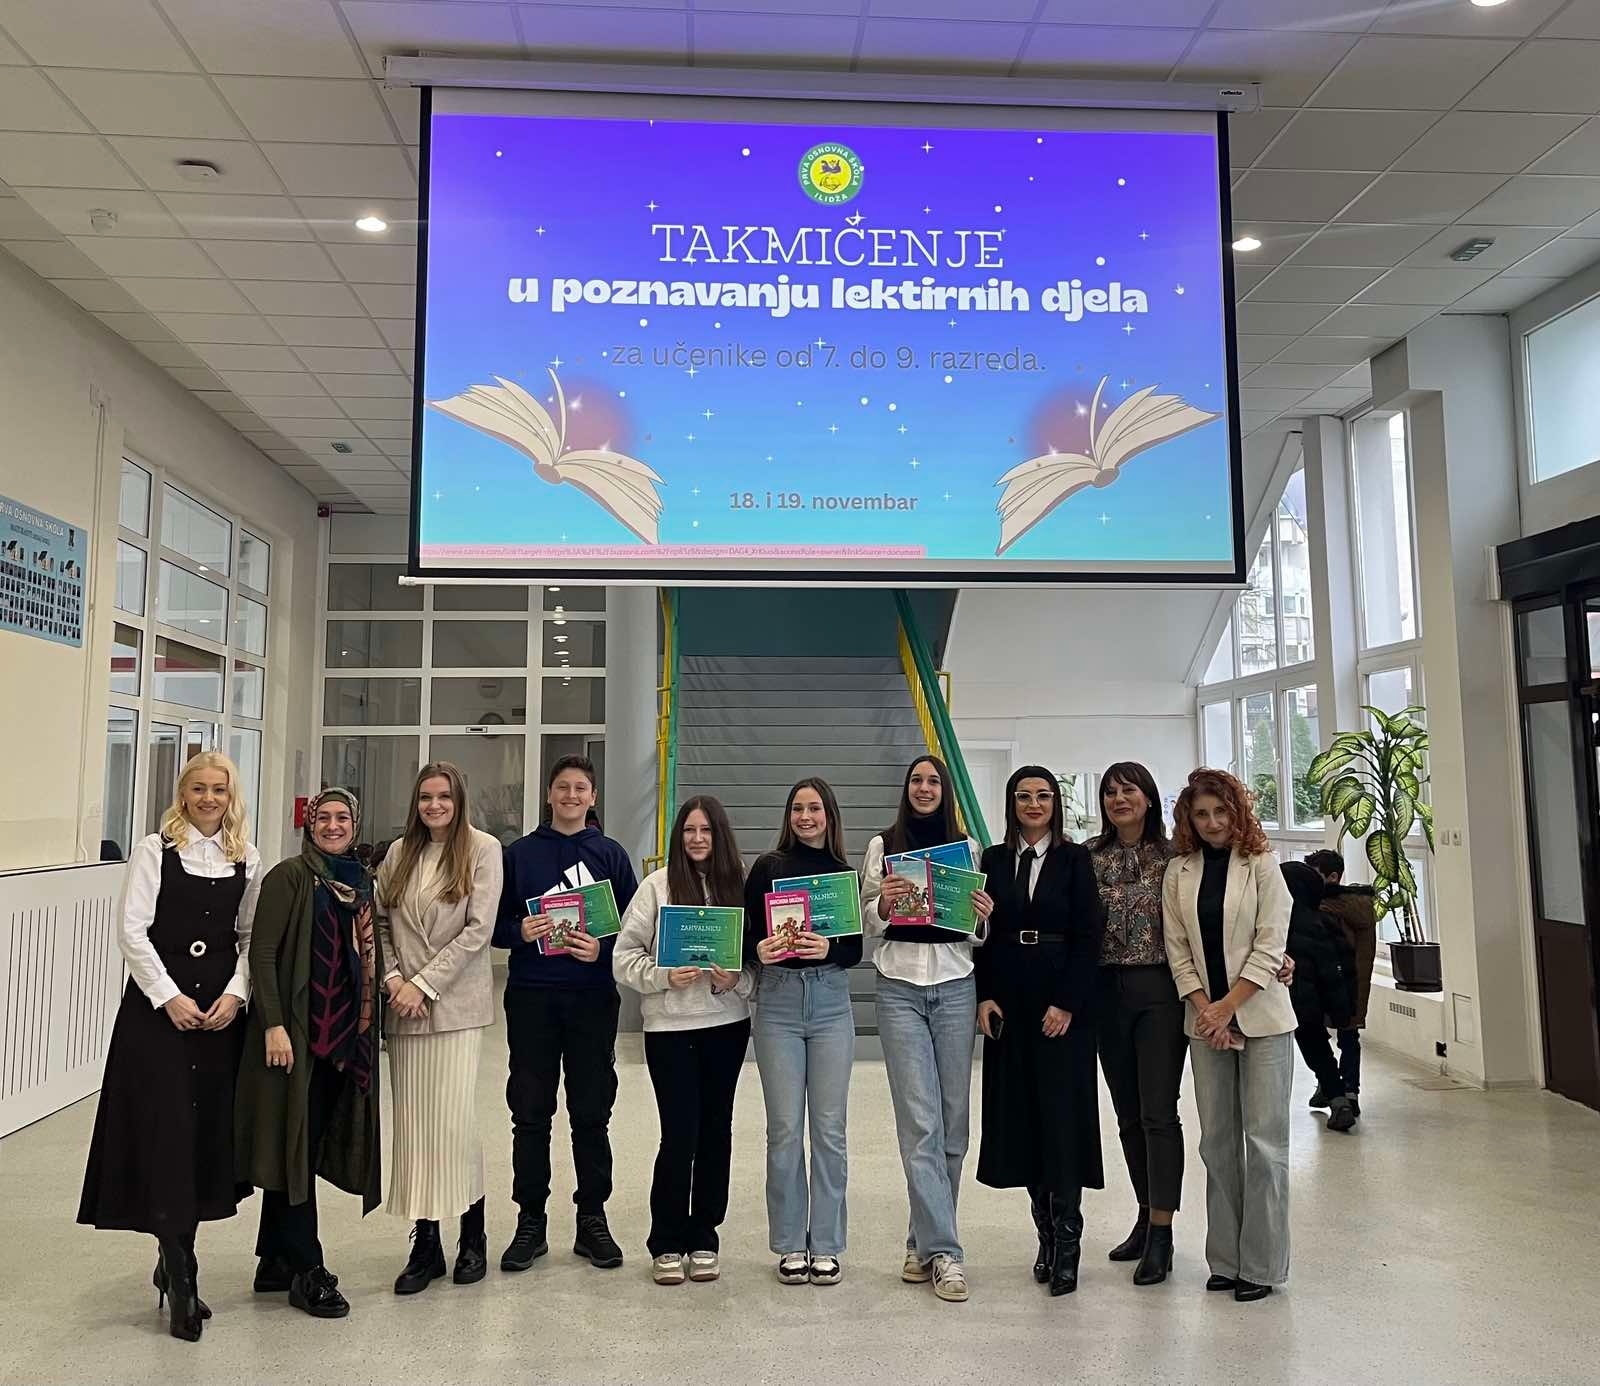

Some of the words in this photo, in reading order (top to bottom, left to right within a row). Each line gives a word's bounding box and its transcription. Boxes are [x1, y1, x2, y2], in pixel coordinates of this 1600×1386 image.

[801, 161, 811, 185] PRVA
[807, 146, 849, 161] OSNOVNA
[651, 217, 1004, 268] TAKMIČENJE
[508, 278, 539, 304] u
[551, 274, 820, 318] poznavanju
[831, 277, 1030, 312] lektirnih
[1041, 279, 1148, 322] djela
[611, 346, 643, 366] za
[653, 339, 766, 368] učenike
[776, 344, 813, 369] od
[821, 346, 840, 368] 7.
[850, 345, 886, 369] do
[896, 346, 920, 369] 9.
[930, 347, 1046, 371] razreda.
[729, 492, 760, 509] 18.
[766, 491, 771, 509] i
[777, 492, 806, 509] 19.
[812, 493, 918, 511] novembar
